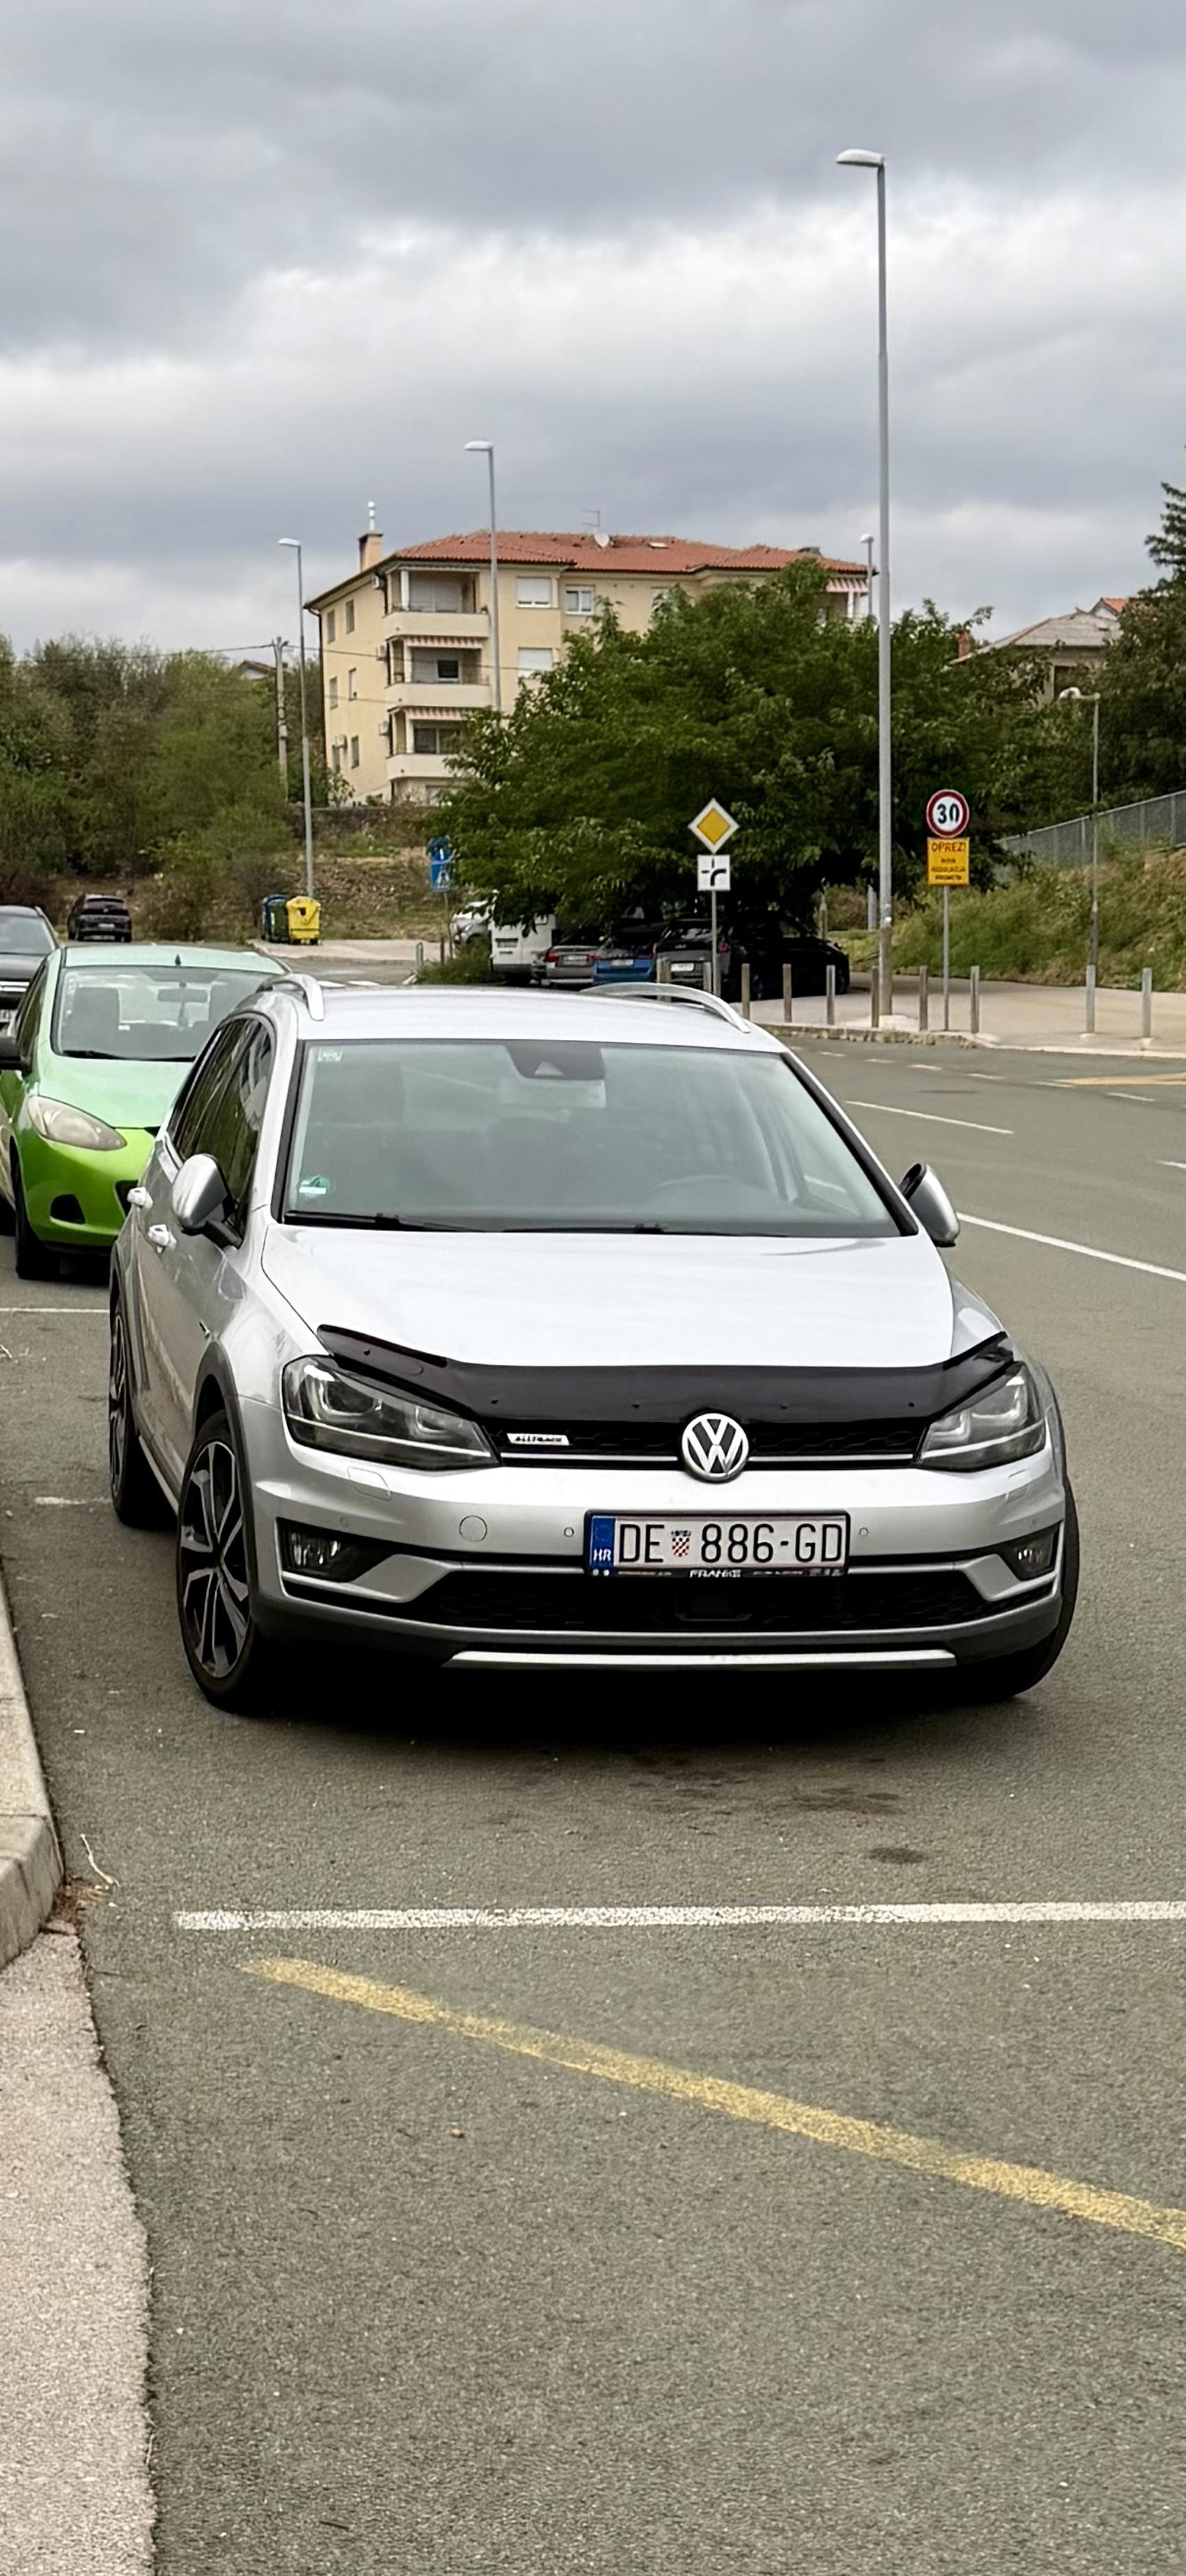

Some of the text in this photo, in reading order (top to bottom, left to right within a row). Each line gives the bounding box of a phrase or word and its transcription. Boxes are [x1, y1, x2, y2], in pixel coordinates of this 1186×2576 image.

[937, 803, 960, 824] 30
[619, 1523, 842, 1563] DE 886-GD
[593, 1548, 611, 1561] HR
